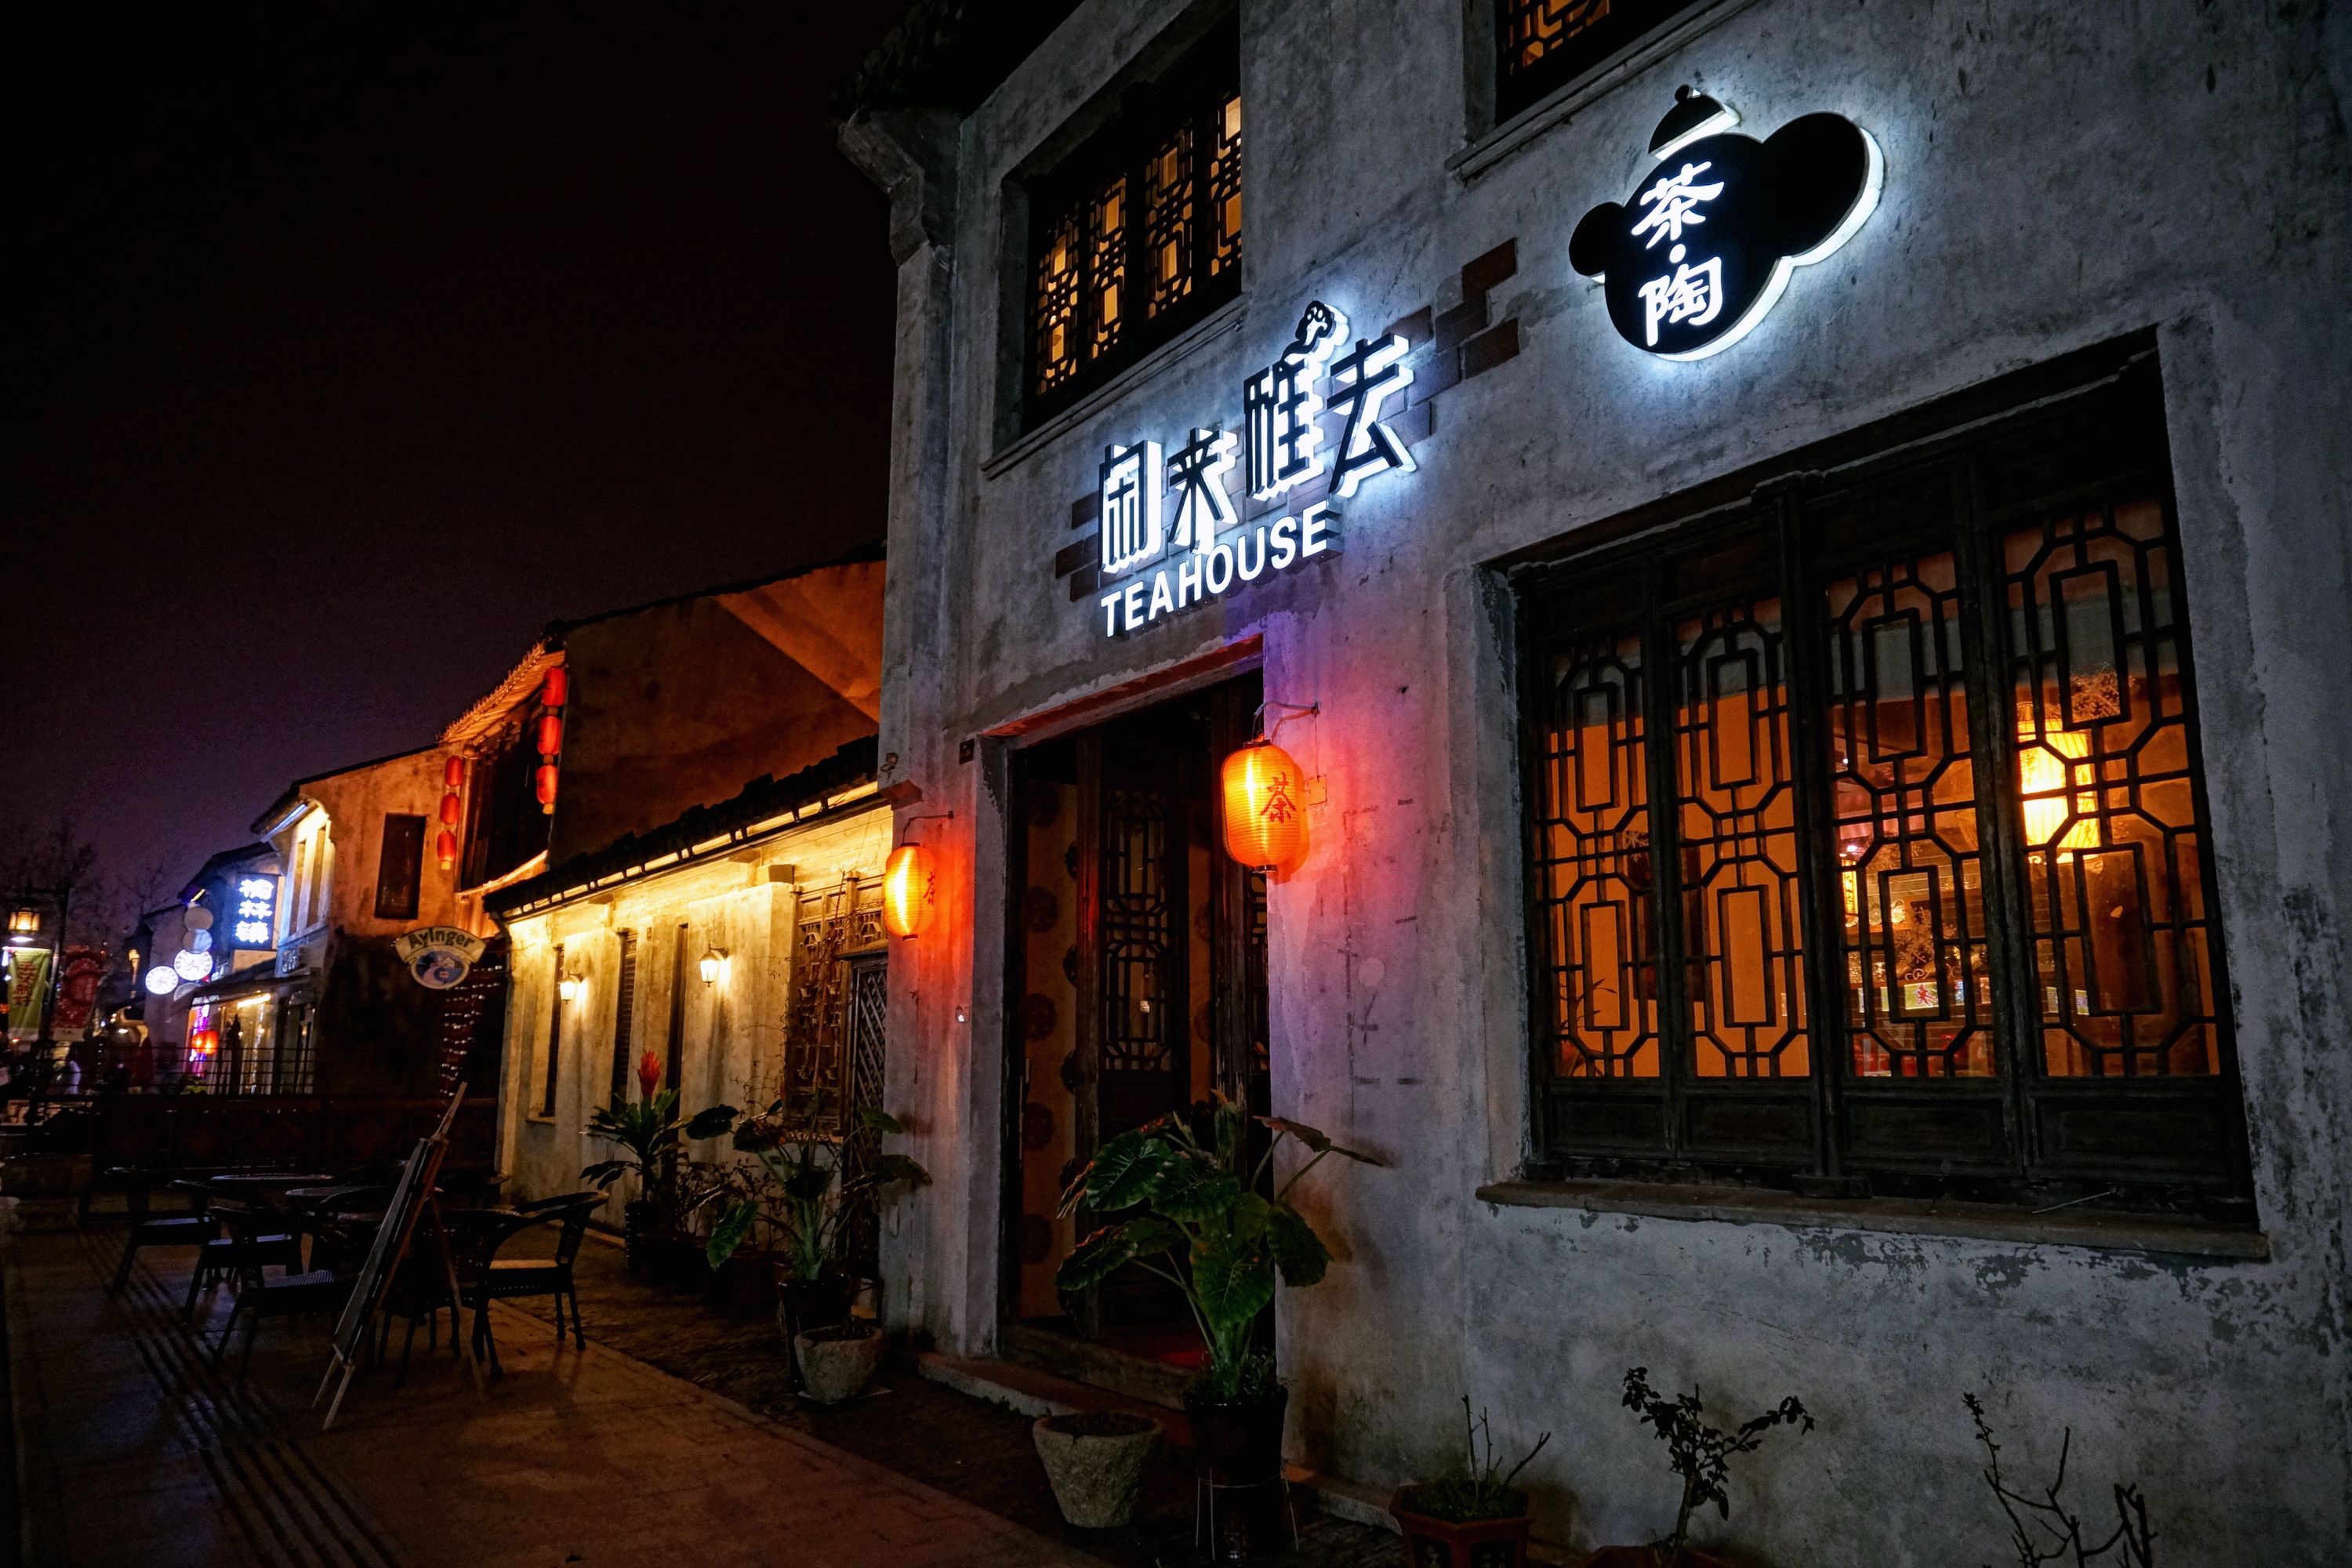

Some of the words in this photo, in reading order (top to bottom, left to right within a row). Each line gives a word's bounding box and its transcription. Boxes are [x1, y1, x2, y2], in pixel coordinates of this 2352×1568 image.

[1101, 499, 1328, 638] TEAHOUSE
[1261, 771, 1297, 823] 茶
[408, 928, 474, 949] Ayinger
